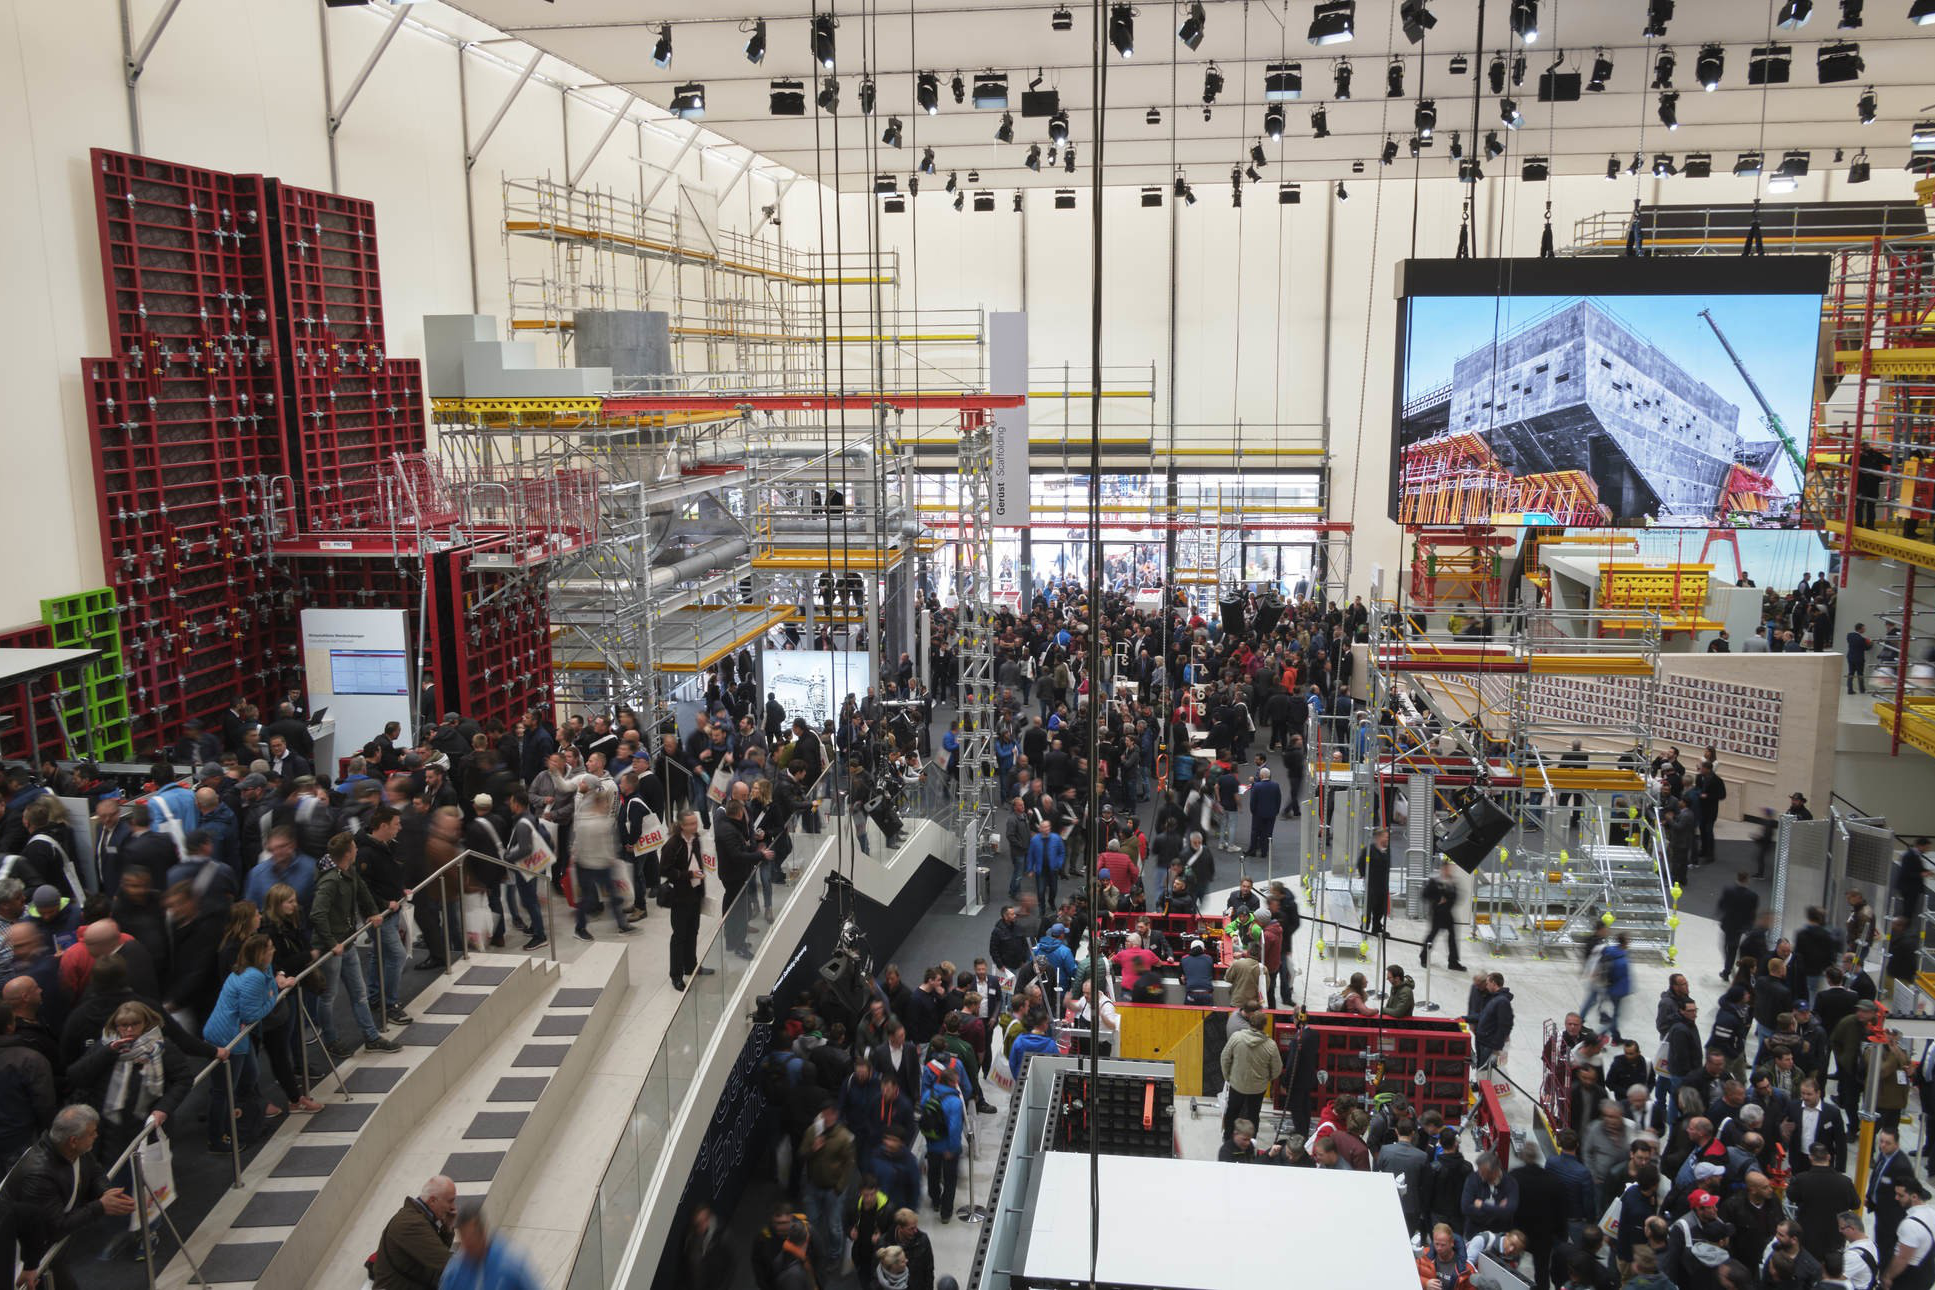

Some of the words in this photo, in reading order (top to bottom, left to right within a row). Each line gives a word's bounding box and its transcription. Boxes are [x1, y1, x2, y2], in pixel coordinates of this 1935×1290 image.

[995, 426, 1006, 476] Scaffolding
[996, 482, 1006, 516] Gerüst
[1197, 704, 1206, 716] 8
[638, 830, 662, 847] PERI
[702, 854, 715, 867] ERI
[1494, 1082, 1510, 1094] ERI
